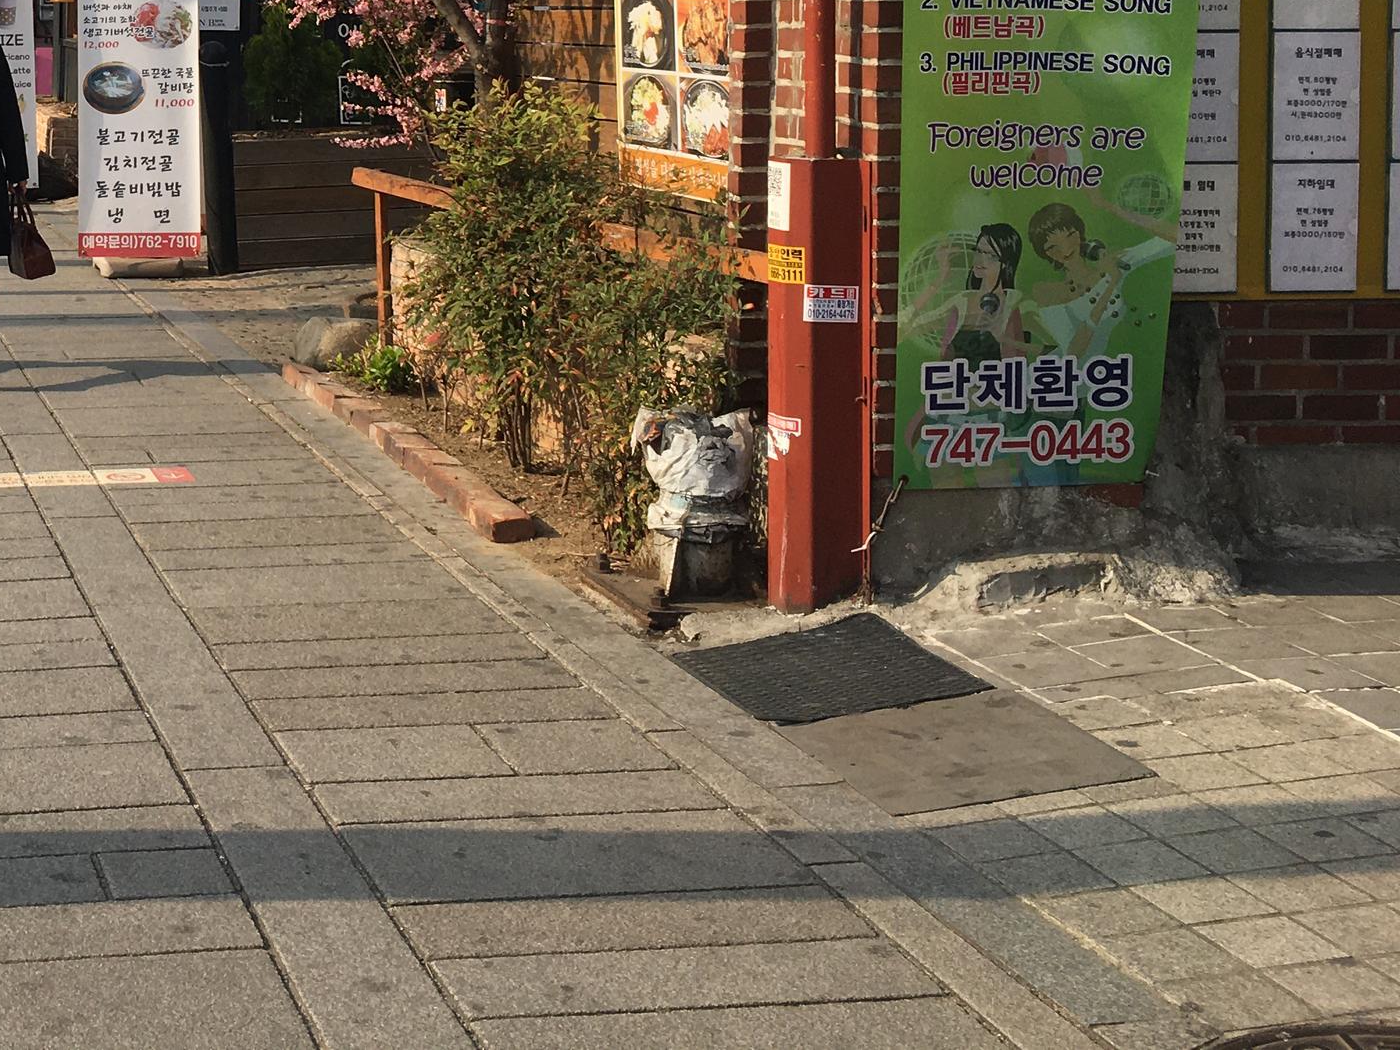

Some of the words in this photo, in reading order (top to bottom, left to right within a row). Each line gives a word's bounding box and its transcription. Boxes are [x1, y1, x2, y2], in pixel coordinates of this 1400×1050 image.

[83, 3, 110, 13] 버섯과
[113, 3, 132, 12] 야채
[83, 16, 116, 24] 소고기의
[120, 15, 136, 24] 조화
[944, 16, 1045, 38] (베트남곡)
[84, 41, 119, 51] 12,000
[142, 67, 171, 78] 뜨끈한
[175, 67, 194, 78] 국물
[920, 53, 937, 72] 3.
[946, 52, 1094, 72] PHILIPPINESE
[1103, 55, 1171, 76] SONG
[158, 82, 194, 94] 갈비탕
[943, 71, 1041, 95] (필리핀곡)
[155, 99, 194, 109] 11,000
[96, 128, 180, 146] 불고기전골
[928, 120, 1083, 152] Foreigners
[1092, 126, 1146, 149] are
[104, 155, 173, 172] 김치전골
[970, 161, 1103, 190] welcome
[1297, 178, 1336, 190] 지하임대
[96, 180, 182, 199] 돌솥비빔밥
[924, 356, 1131, 411] 단체환영
[924, 422, 1132, 465] 747-0443
